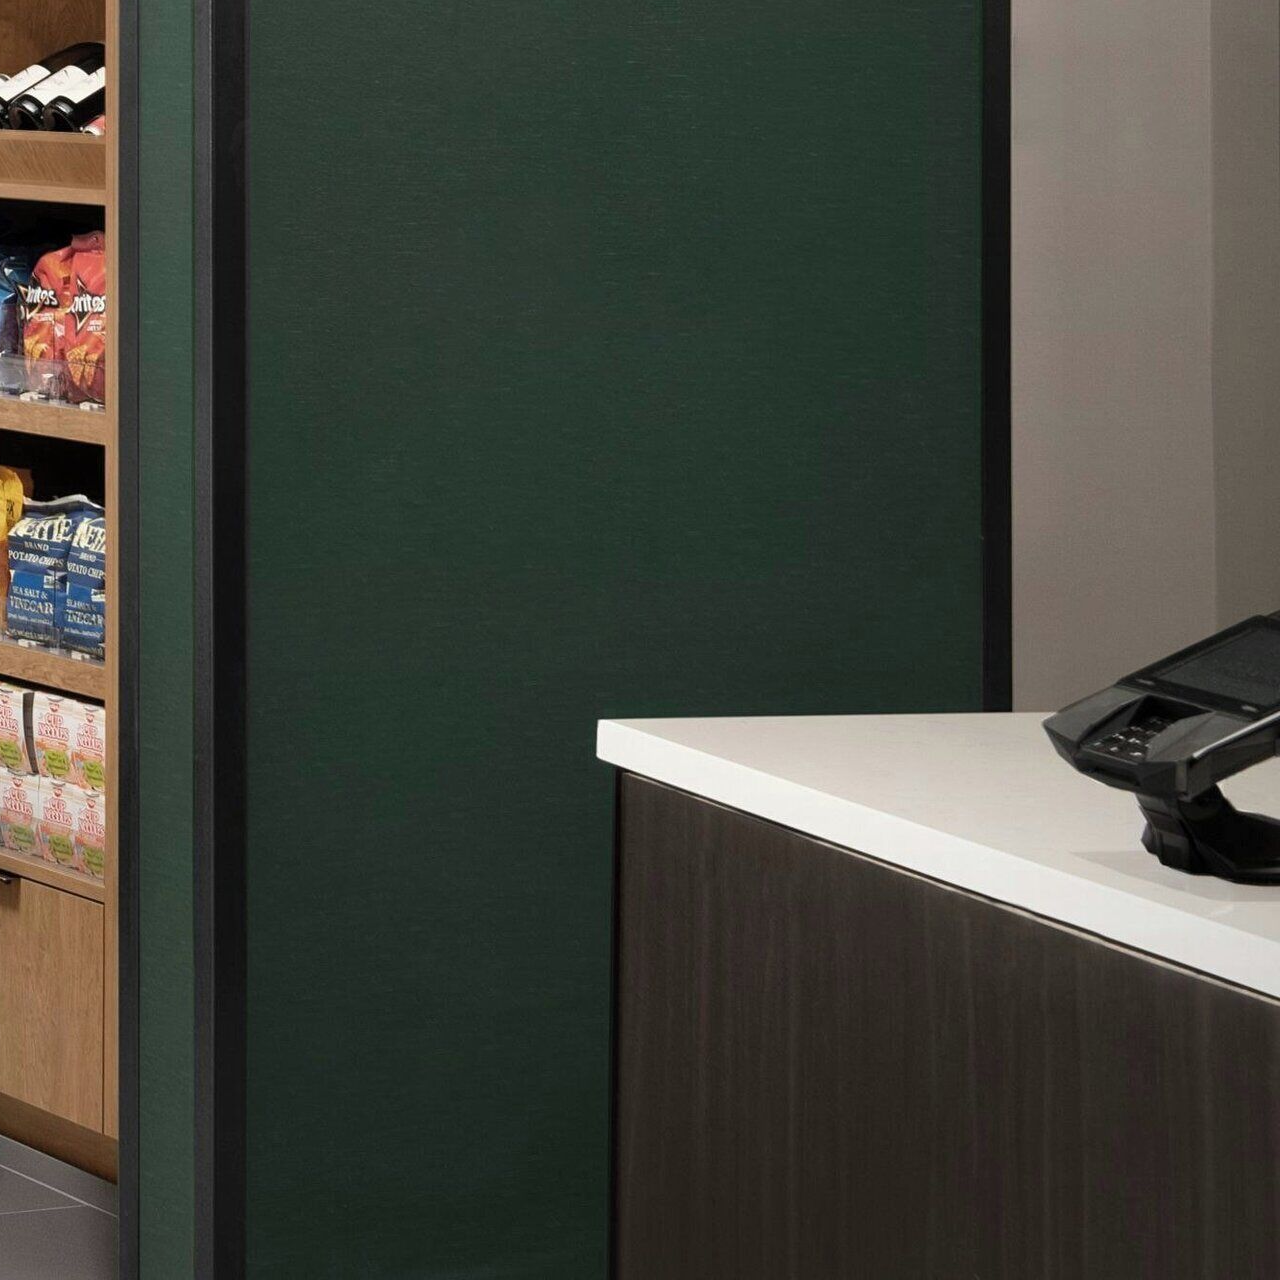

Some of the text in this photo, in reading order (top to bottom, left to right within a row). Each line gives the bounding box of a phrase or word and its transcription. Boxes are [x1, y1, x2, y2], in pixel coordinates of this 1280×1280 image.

[8, 550, 37, 563] POTATO
[66, 562, 105, 579] OTATO CHIP
[25, 588, 40, 599] SALT
